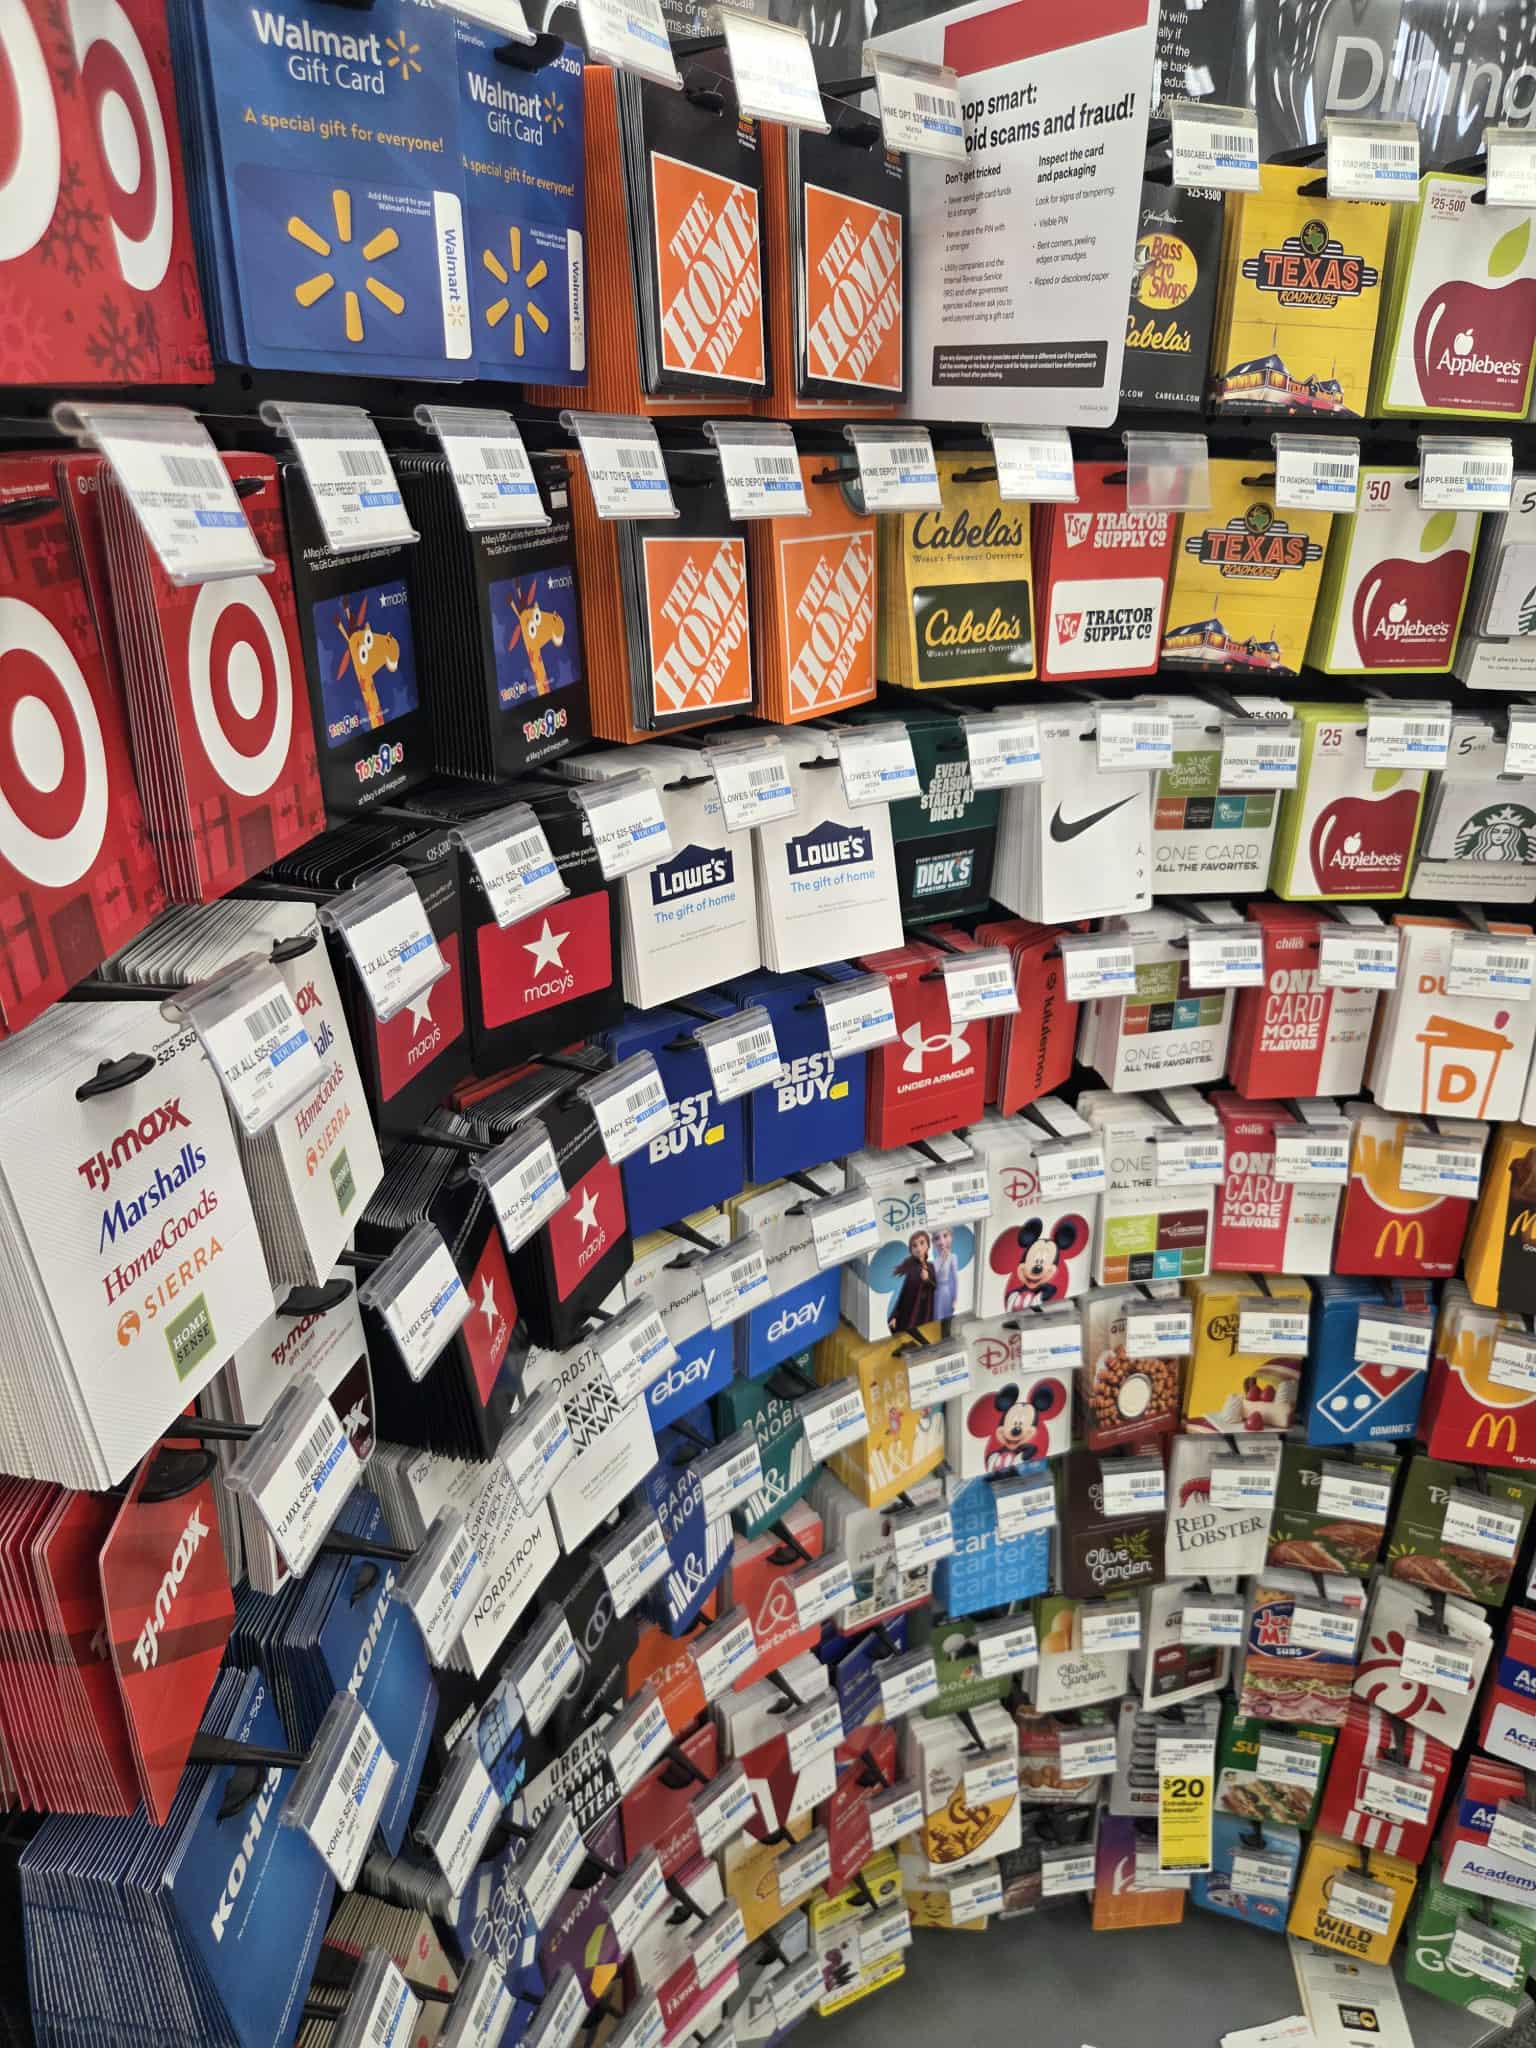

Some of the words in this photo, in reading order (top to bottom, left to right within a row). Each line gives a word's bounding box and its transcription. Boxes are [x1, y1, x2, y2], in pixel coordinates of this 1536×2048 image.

[252, 10, 381, 66] Walmart
[289, 55, 333, 86] Gift
[336, 62, 384, 95] Card
[468, 72, 541, 121] Walmart
[988, 83, 1038, 115] smart:
[244, 107, 257, 124] A
[261, 112, 316, 133] special
[320, 118, 346, 140] gift
[352, 124, 371, 141] for
[377, 129, 444, 152] everyone!
[488, 112, 512, 137] Gift
[514, 123, 543, 146] Card
[990, 119, 1040, 148] scams
[1044, 106, 1075, 135] and
[1079, 93, 1136, 127] fraud!
[1039, 152, 1068, 167] Inspect
[1070, 148, 1083, 162] the
[1084, 144, 1104, 158] card
[470, 160, 502, 177] special
[504, 167, 520, 184] gift
[522, 172, 535, 186] for
[537, 178, 575, 196] everyone!
[945, 171, 964, 184] Don't
[964, 170, 975, 184] get
[976, 165, 1001, 179] tricked
[1038, 168, 1052, 184] and
[1054, 164, 1096, 181] packaging
[1431, 197, 1466, 213] $25-500
[668, 191, 714, 270] THE
[444, 229, 461, 301] Walmart
[818, 216, 860, 288] THE
[1152, 236, 1183, 262] Bass
[662, 184, 759, 369] HOME
[1154, 258, 1175, 278] Pro
[1263, 255, 1361, 291] TEXAS
[572, 261, 580, 321] Walmart
[807, 211, 901, 377] HOME
[1149, 276, 1188, 302] Shops
[1279, 291, 1338, 306] ROADHOUSE
[705, 262, 760, 375] DEPOT
[846, 280, 902, 382] DEPOT
[1125, 315, 1192, 353] Cabela's
[1437, 346, 1521, 377] Applebee's
[1366, 480, 1392, 501] $50
[912, 508, 1023, 549] Cabela's
[1067, 513, 1088, 540] TSC
[1097, 512, 1168, 530] TRACTOR
[1093, 530, 1147, 548] SUPPLY
[1207, 533, 1305, 564] TEXAS
[1222, 565, 1280, 575] ROADHOUSE
[660, 555, 704, 628] THE
[795, 554, 836, 624] THE
[654, 539, 747, 711] HOME
[789, 535, 873, 706] HOME
[924, 607, 1022, 647] Cabela's
[1057, 616, 1079, 637] TSC
[1086, 607, 1153, 625] TRACTOR
[1083, 622, 1134, 643] SUPPLY
[1373, 618, 1450, 640] Applebee's
[695, 602, 750, 705] DEPOT
[825, 596, 873, 699] DEPOT
[1319, 728, 1342, 746] $25
[928, 776, 971, 794] SEASON
[934, 761, 968, 779] EVERY
[920, 792, 960, 810] STARTS
[930, 804, 964, 822] DICK'S
[794, 834, 865, 868] LOWE'S
[1155, 863, 1175, 872] ALL
[1178, 863, 1199, 872] THE
[1200, 862, 1259, 872] FAVORITES.
[1156, 845, 1199, 861] ONE
[1205, 844, 1260, 860] CARD
[1329, 849, 1402, 869] Applebee's
[658, 857, 728, 897] LOWE'S
[790, 880, 813, 894] The
[814, 877, 833, 892] gift
[834, 874, 845, 885] of
[847, 869, 876, 882] home
[916, 857, 971, 888] DICK'S
[653, 910, 675, 925] The
[677, 902, 695, 921] gift
[696, 900, 708, 912] of
[708, 892, 737, 909] home
[524, 969, 574, 1003] macy's
[1264, 995, 1325, 1024] CARD
[1034, 996, 1056, 1089] lululemon
[1259, 1039, 1317, 1051] FLAVORS
[1261, 1023, 1320, 1038] MORE
[1123, 1063, 1142, 1073] ALL
[1144, 1060, 1161, 1071] THE
[1125, 1045, 1161, 1063] ONE
[1166, 1040, 1213, 1059] CARD
[772, 1050, 836, 1089] BEST
[896, 1078, 932, 1094] UNDER
[933, 1066, 974, 1085] ARMOUR
[1437, 1064, 1477, 1103] D
[295, 1062, 344, 1138] HomeGoods
[777, 1075, 834, 1112] BUY
[318, 1102, 351, 1158] SIERRA
[649, 1118, 707, 1165] BUY
[99, 1142, 207, 1256] Marshalls
[1225, 1175, 1285, 1202] CARD
[1221, 1216, 1280, 1228] FLAVORS
[1223, 1202, 1283, 1216] MORE
[102, 1186, 219, 1307] HomeGoods
[144, 1235, 224, 1320] SIERRA
[172, 1308, 207, 1350] HOME
[767, 1296, 825, 1343] ebay
[175, 1322, 212, 1365] SENSE
[651, 1349, 716, 1405] ebay
[1369, 1423, 1412, 1436] DOMINO'S
[1175, 1513, 1217, 1535] RED
[1177, 1515, 1266, 1552] LOBSTER
[1085, 1550, 1129, 1567] Olive
[1091, 1560, 1153, 1586] Garden
[473, 1527, 543, 1629] NORDSTROM
[1163, 1778, 1205, 1798] $20
[1463, 1861, 1536, 1892] Academy
[1313, 1927, 1370, 1953] WINGS
[1315, 1914, 1373, 1945] WILD
